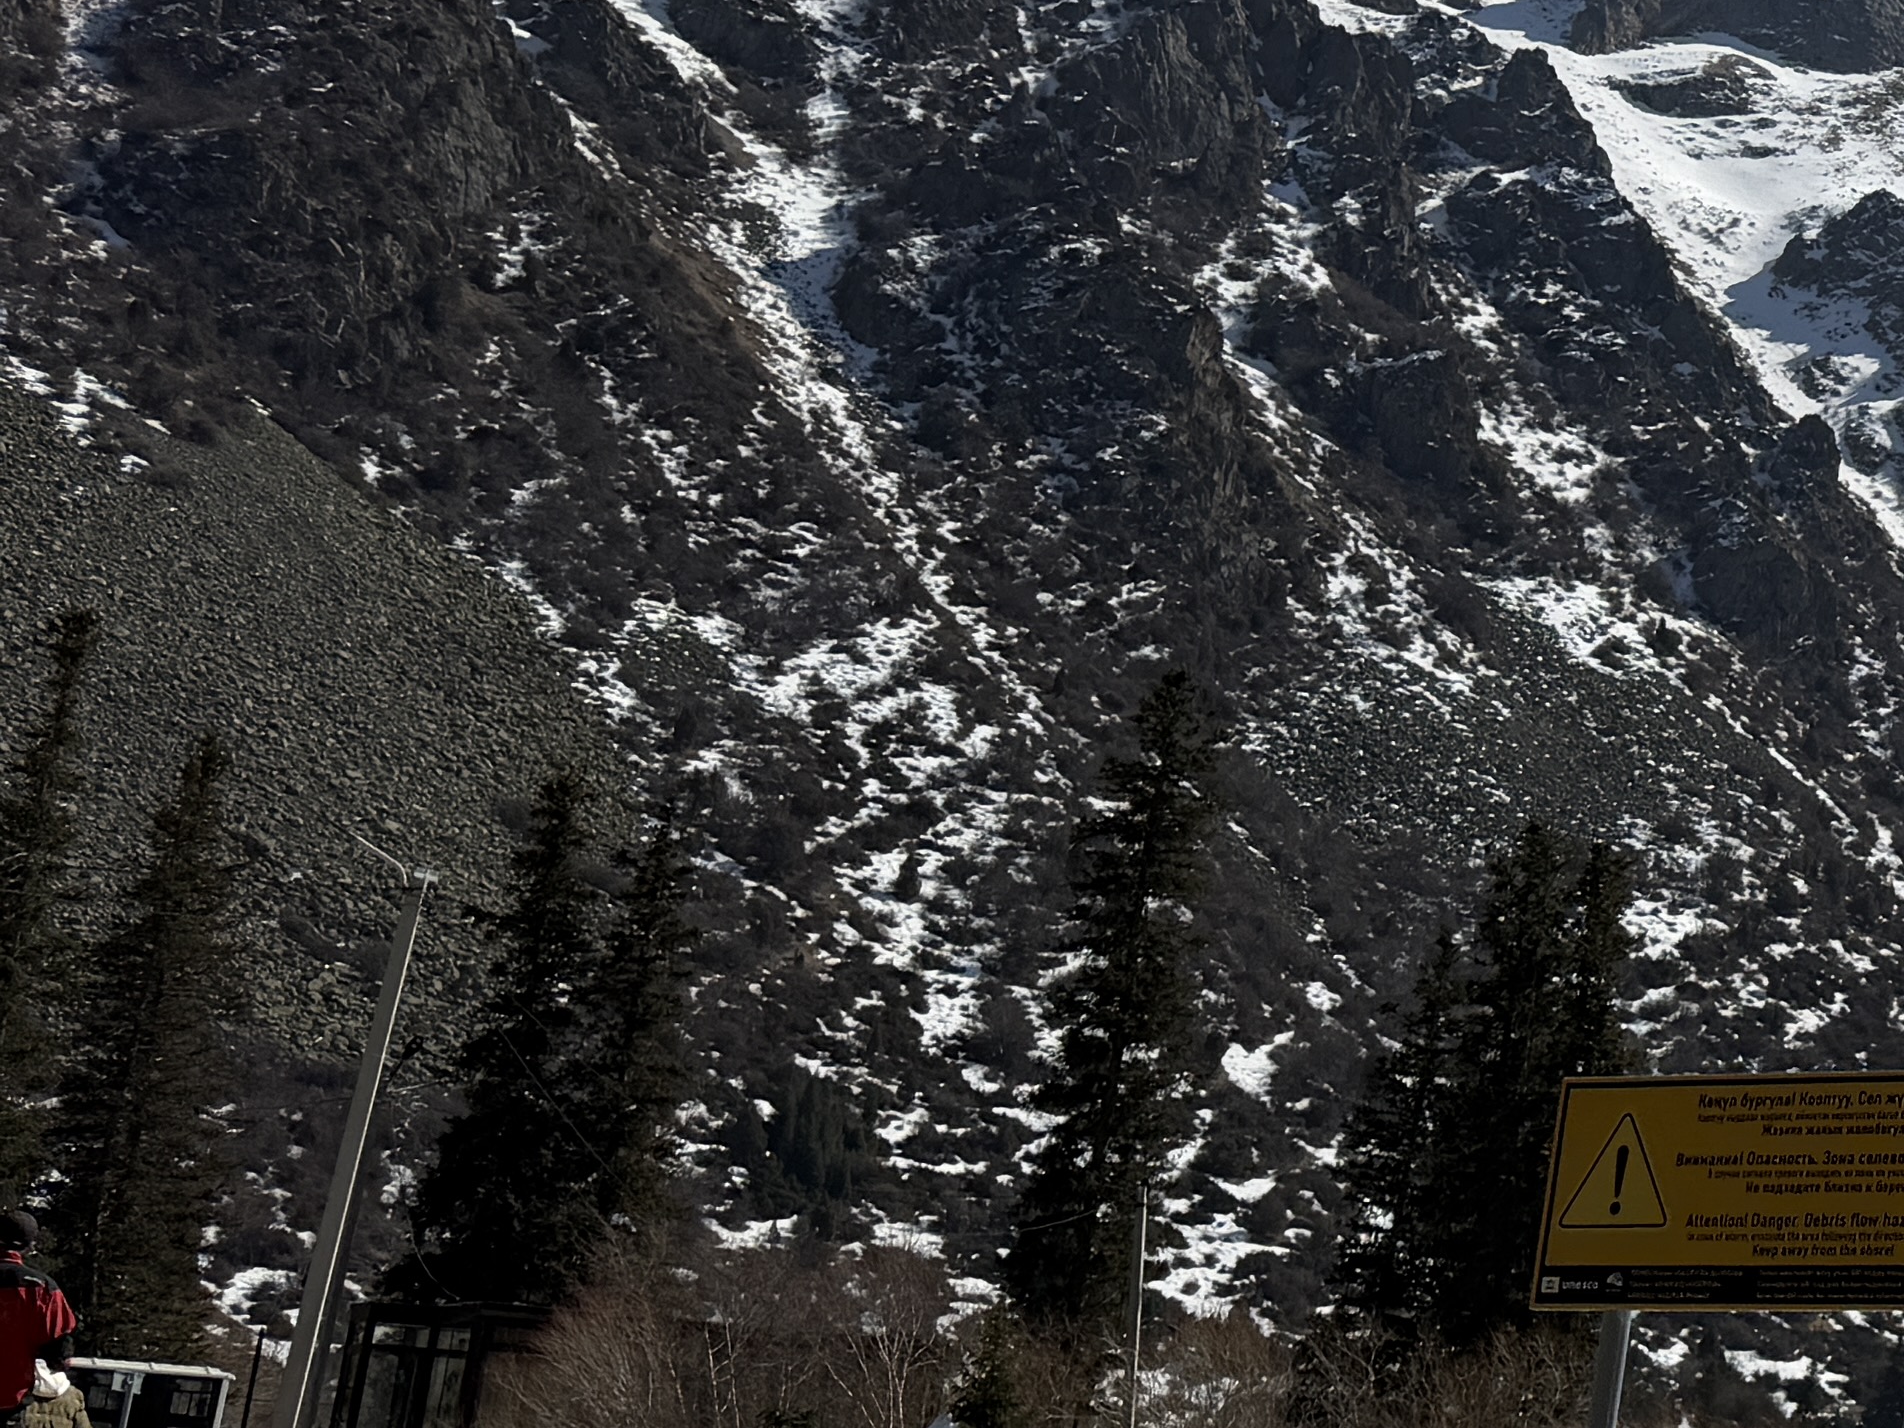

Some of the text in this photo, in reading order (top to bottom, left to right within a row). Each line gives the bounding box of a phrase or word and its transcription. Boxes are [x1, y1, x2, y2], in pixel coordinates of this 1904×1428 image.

[1822, 1149, 1854, 1165] Зона
[1685, 1213, 1748, 1228] Attention!
[1804, 1212, 1847, 1228] Debris
[1850, 1212, 1879, 1228] flow
[1810, 1243, 1837, 1257] from
